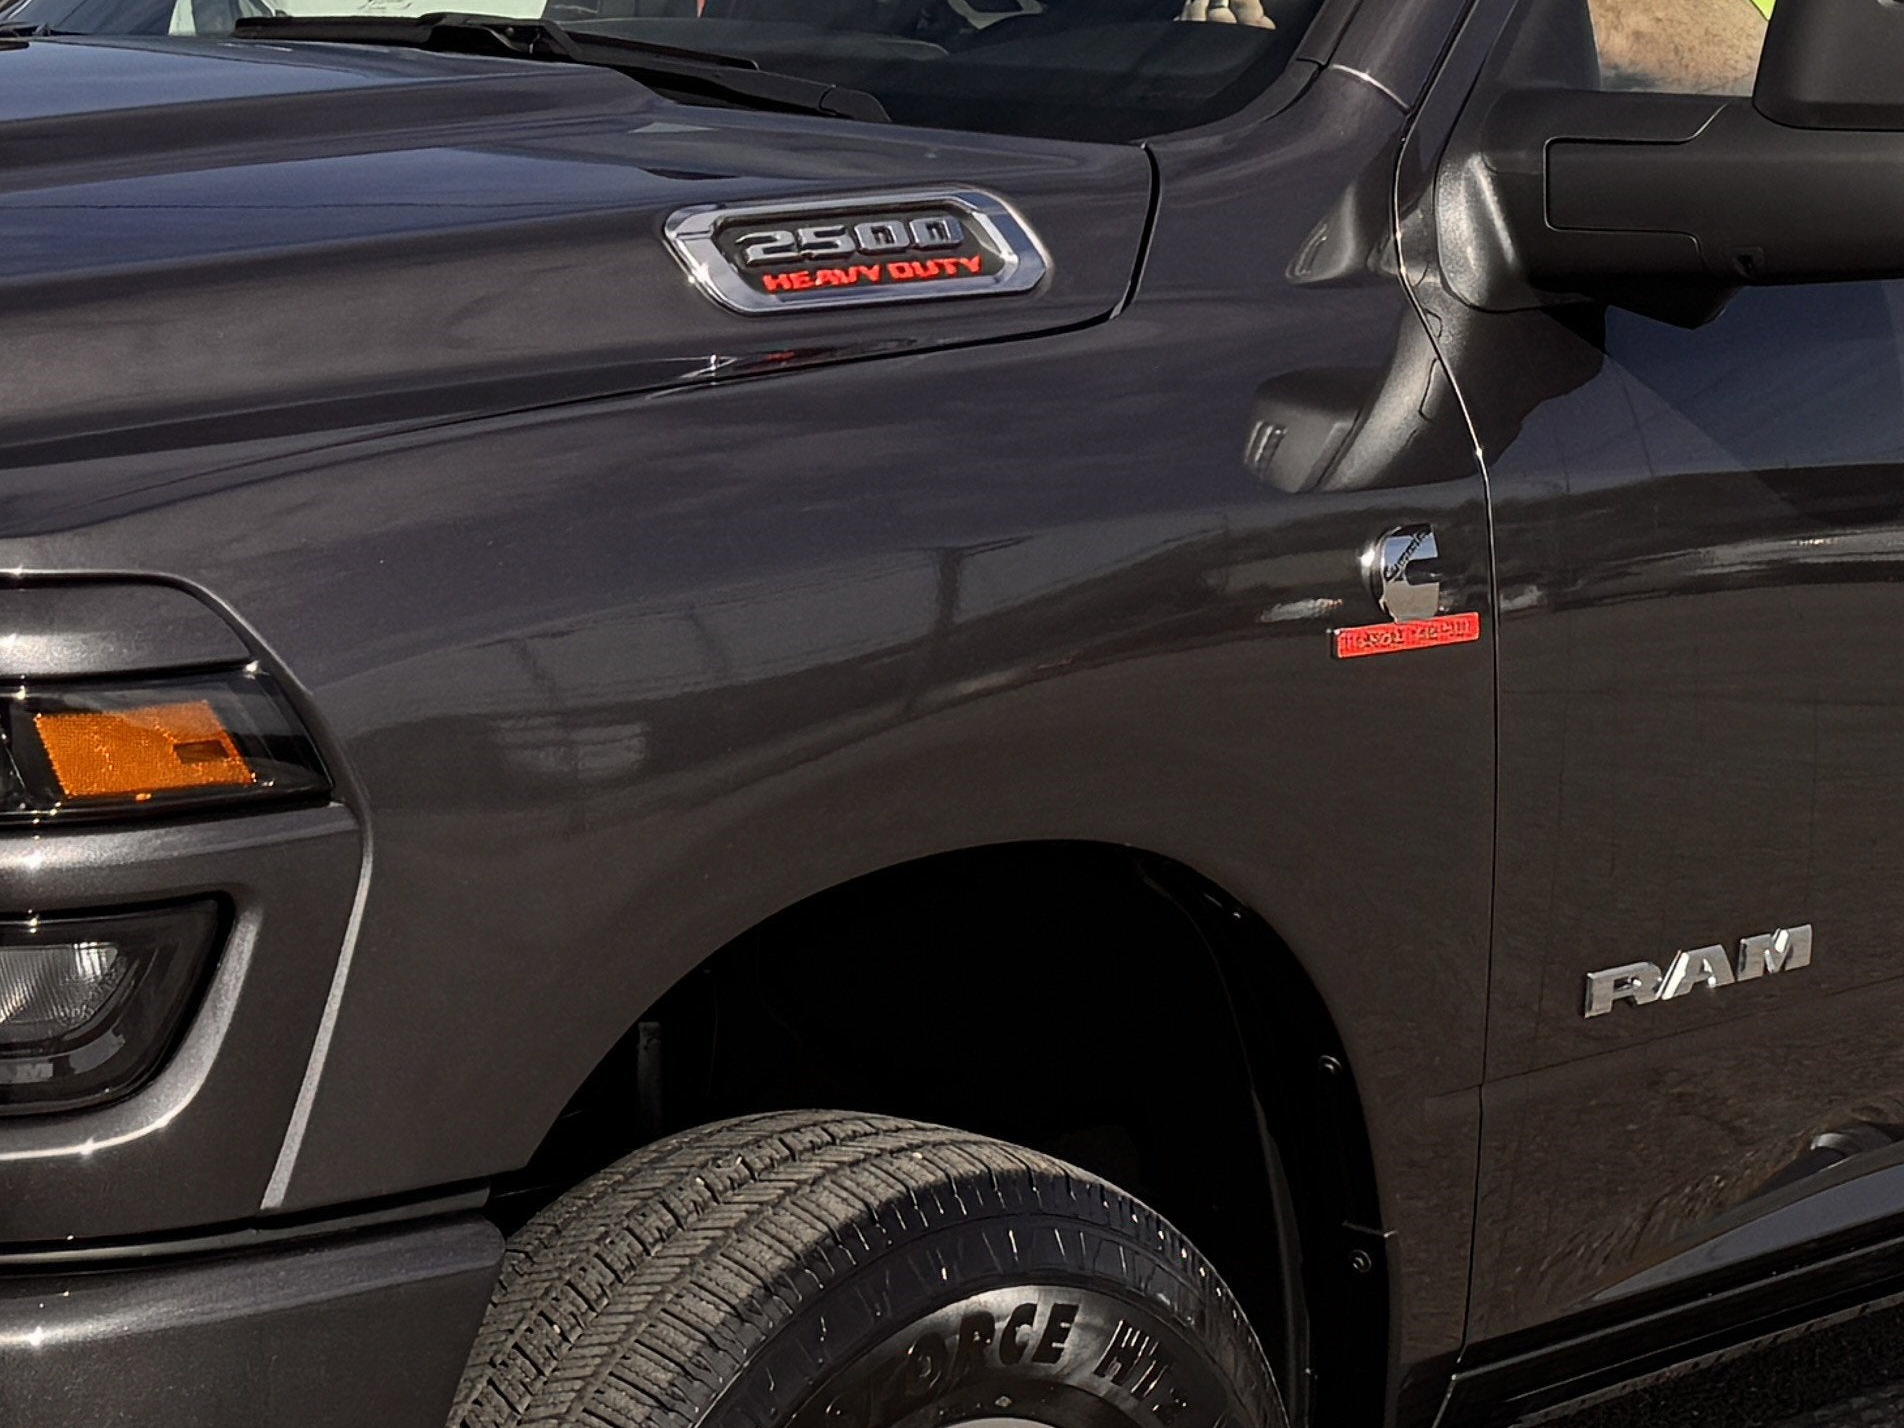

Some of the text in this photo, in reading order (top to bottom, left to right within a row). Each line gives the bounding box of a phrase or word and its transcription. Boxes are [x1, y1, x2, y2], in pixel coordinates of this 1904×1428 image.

[736, 217, 965, 266] 2500
[762, 253, 982, 293] HEAVY DUTY
[1584, 923, 1813, 1019] RAM
